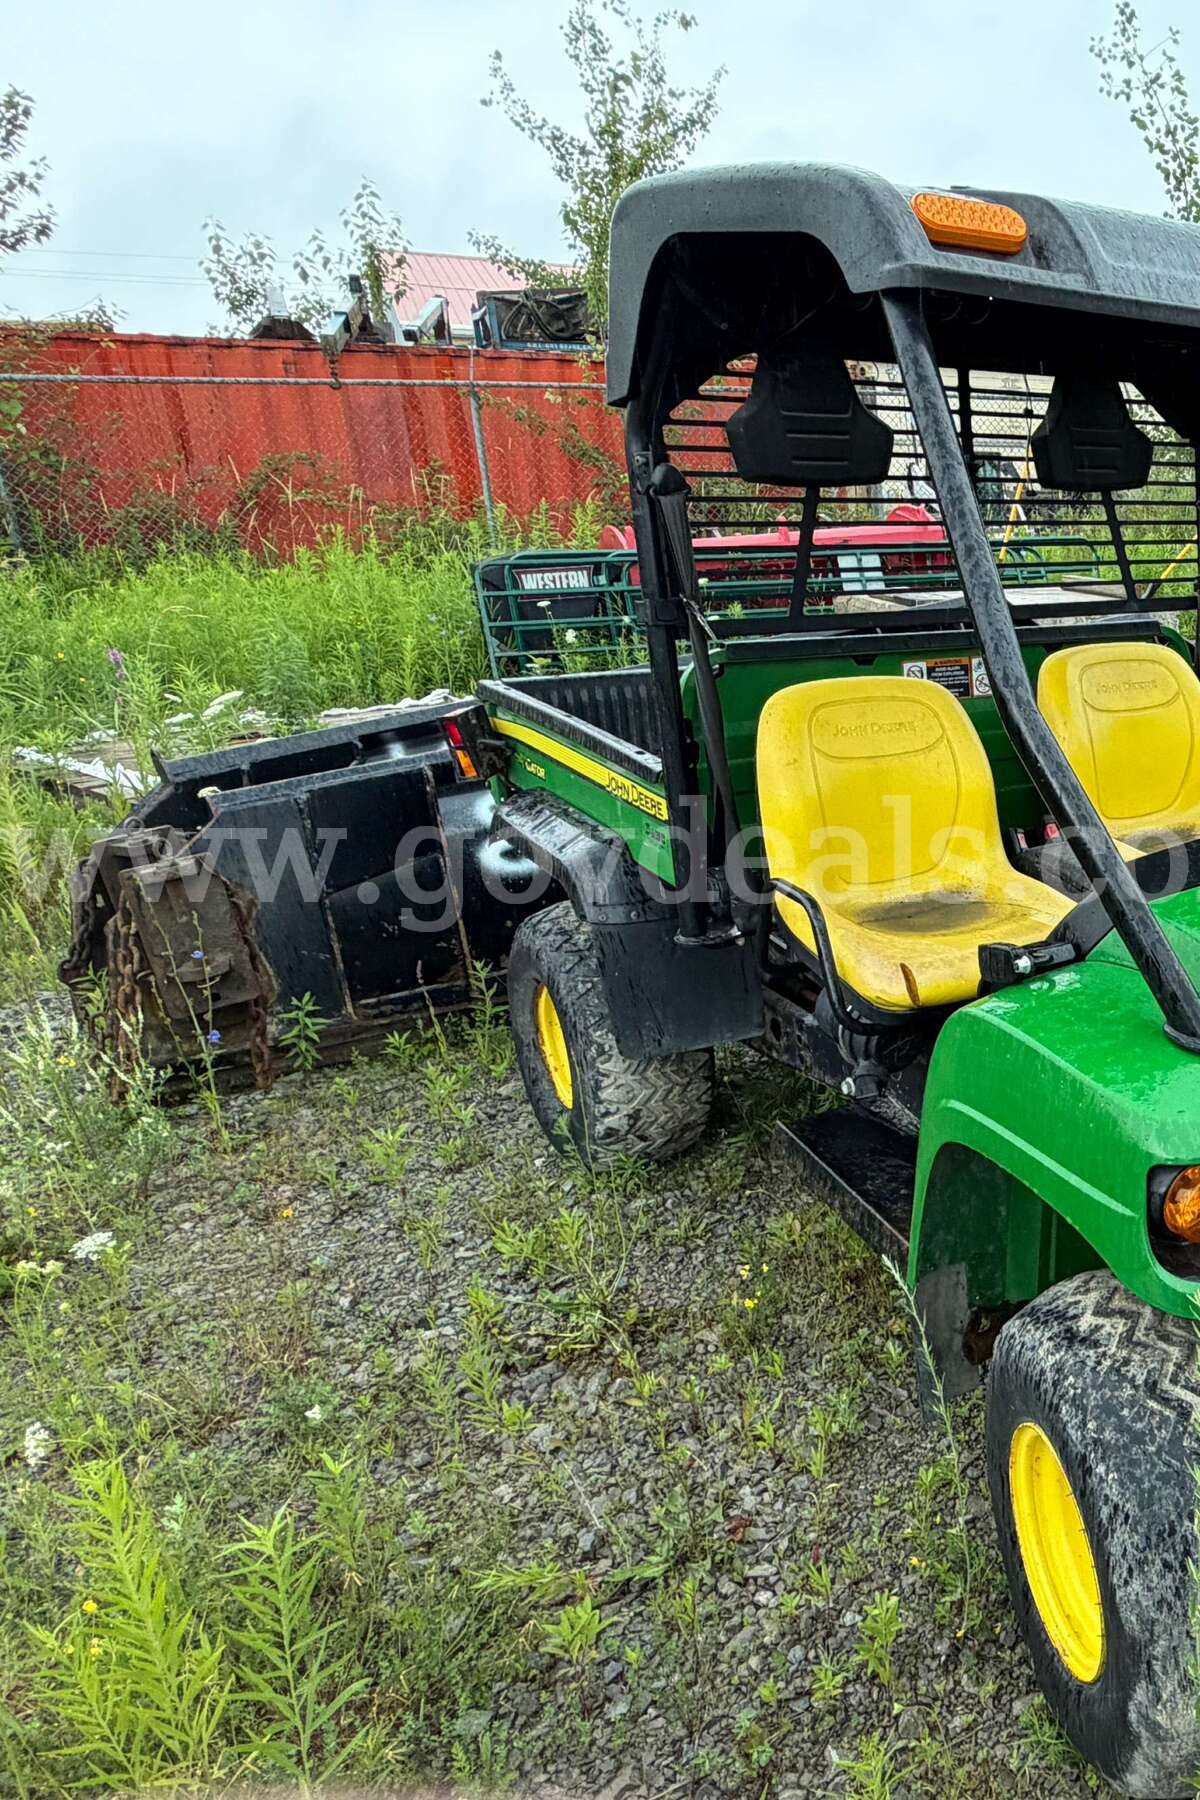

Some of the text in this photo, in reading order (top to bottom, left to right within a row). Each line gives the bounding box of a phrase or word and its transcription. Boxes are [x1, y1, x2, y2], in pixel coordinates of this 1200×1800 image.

[521, 570, 589, 590] WESTERN
[524, 758, 546, 780] GATOR
[605, 771, 665, 818] JOHN DEERE
